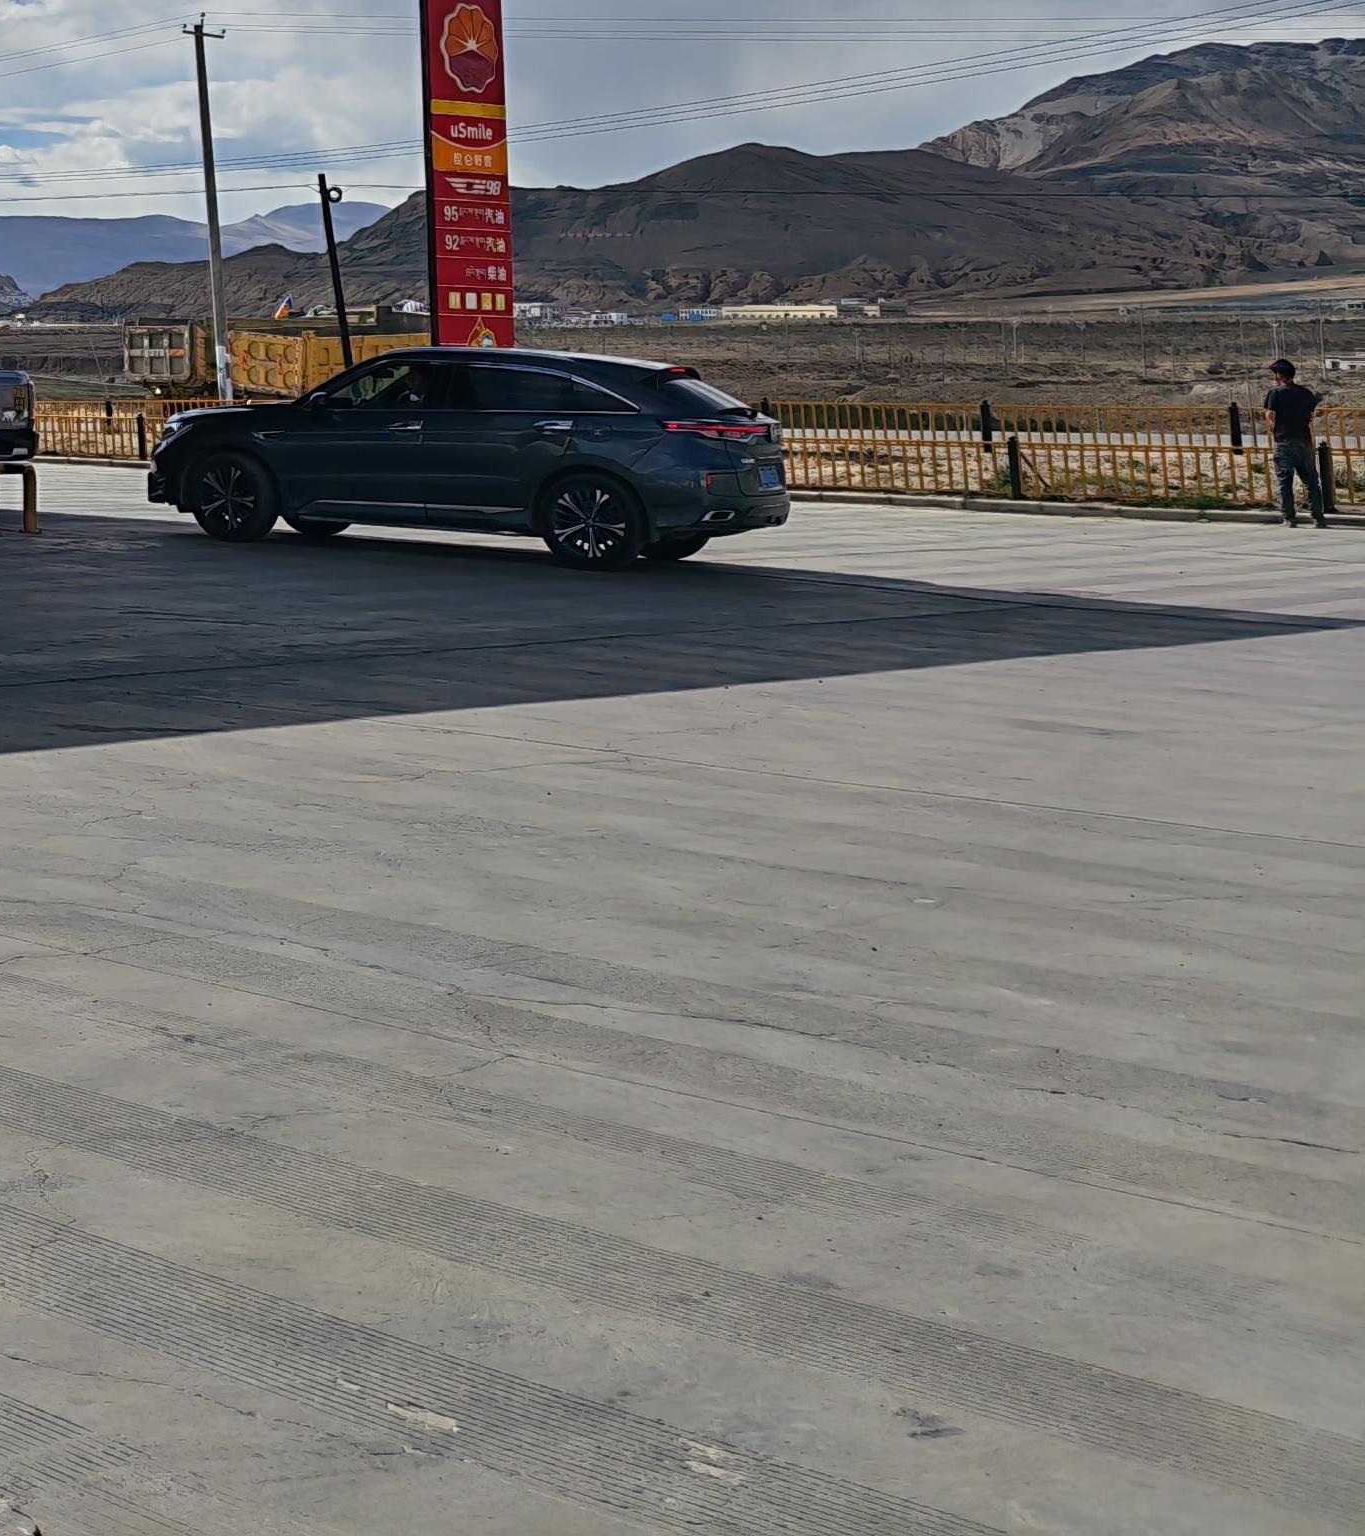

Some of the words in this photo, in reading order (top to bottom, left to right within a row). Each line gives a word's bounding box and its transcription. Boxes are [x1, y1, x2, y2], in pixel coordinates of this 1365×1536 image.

[450, 122, 493, 141] uSmile
[443, 205, 459, 222] 95
[485, 207, 505, 224] 汽油
[445, 234, 461, 251] 92
[486, 236, 506, 253] 汽油
[487, 265, 507, 282] 柴油
